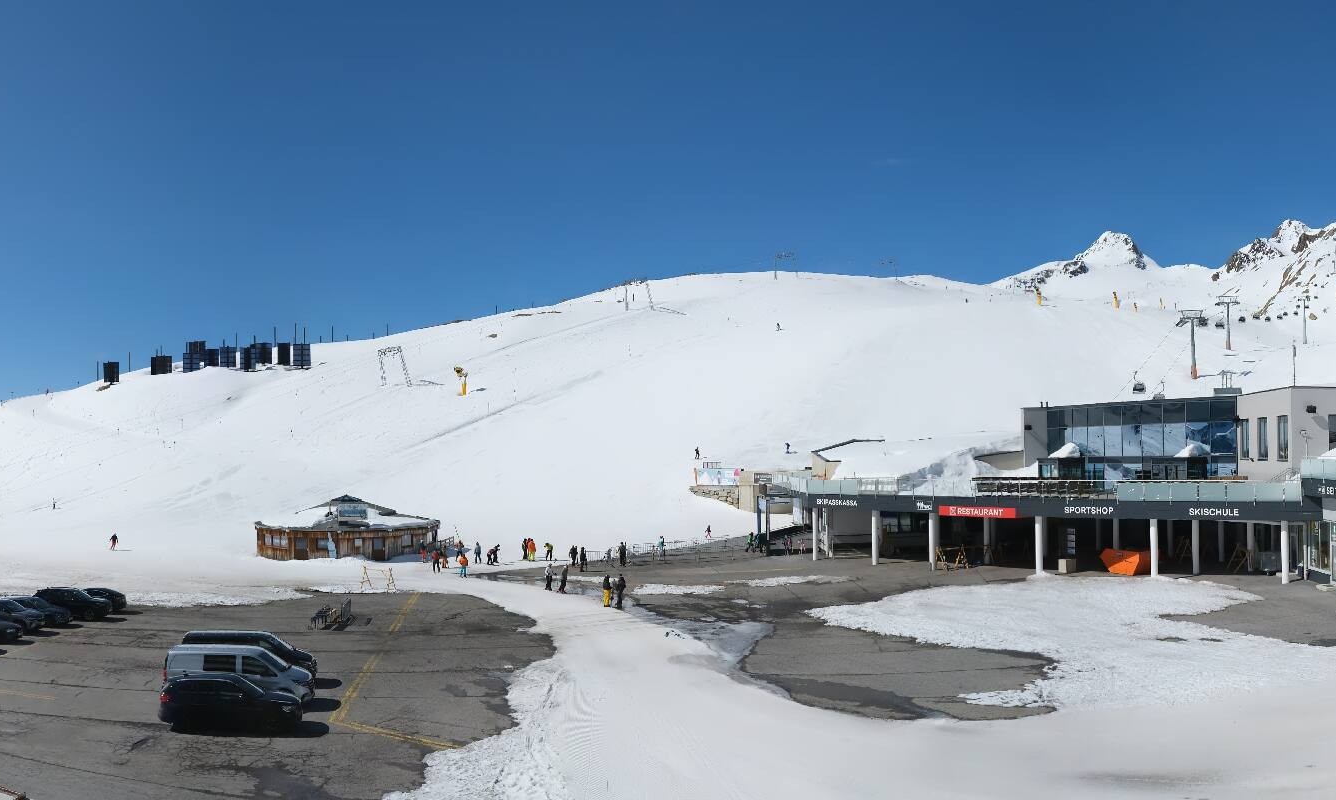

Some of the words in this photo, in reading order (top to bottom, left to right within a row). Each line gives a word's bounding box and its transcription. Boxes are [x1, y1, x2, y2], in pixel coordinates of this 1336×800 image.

[957, 507, 1004, 516] RESTAURANT
[1064, 506, 1114, 515] SPORTSHOP
[1188, 507, 1240, 516] SKISCHULE
